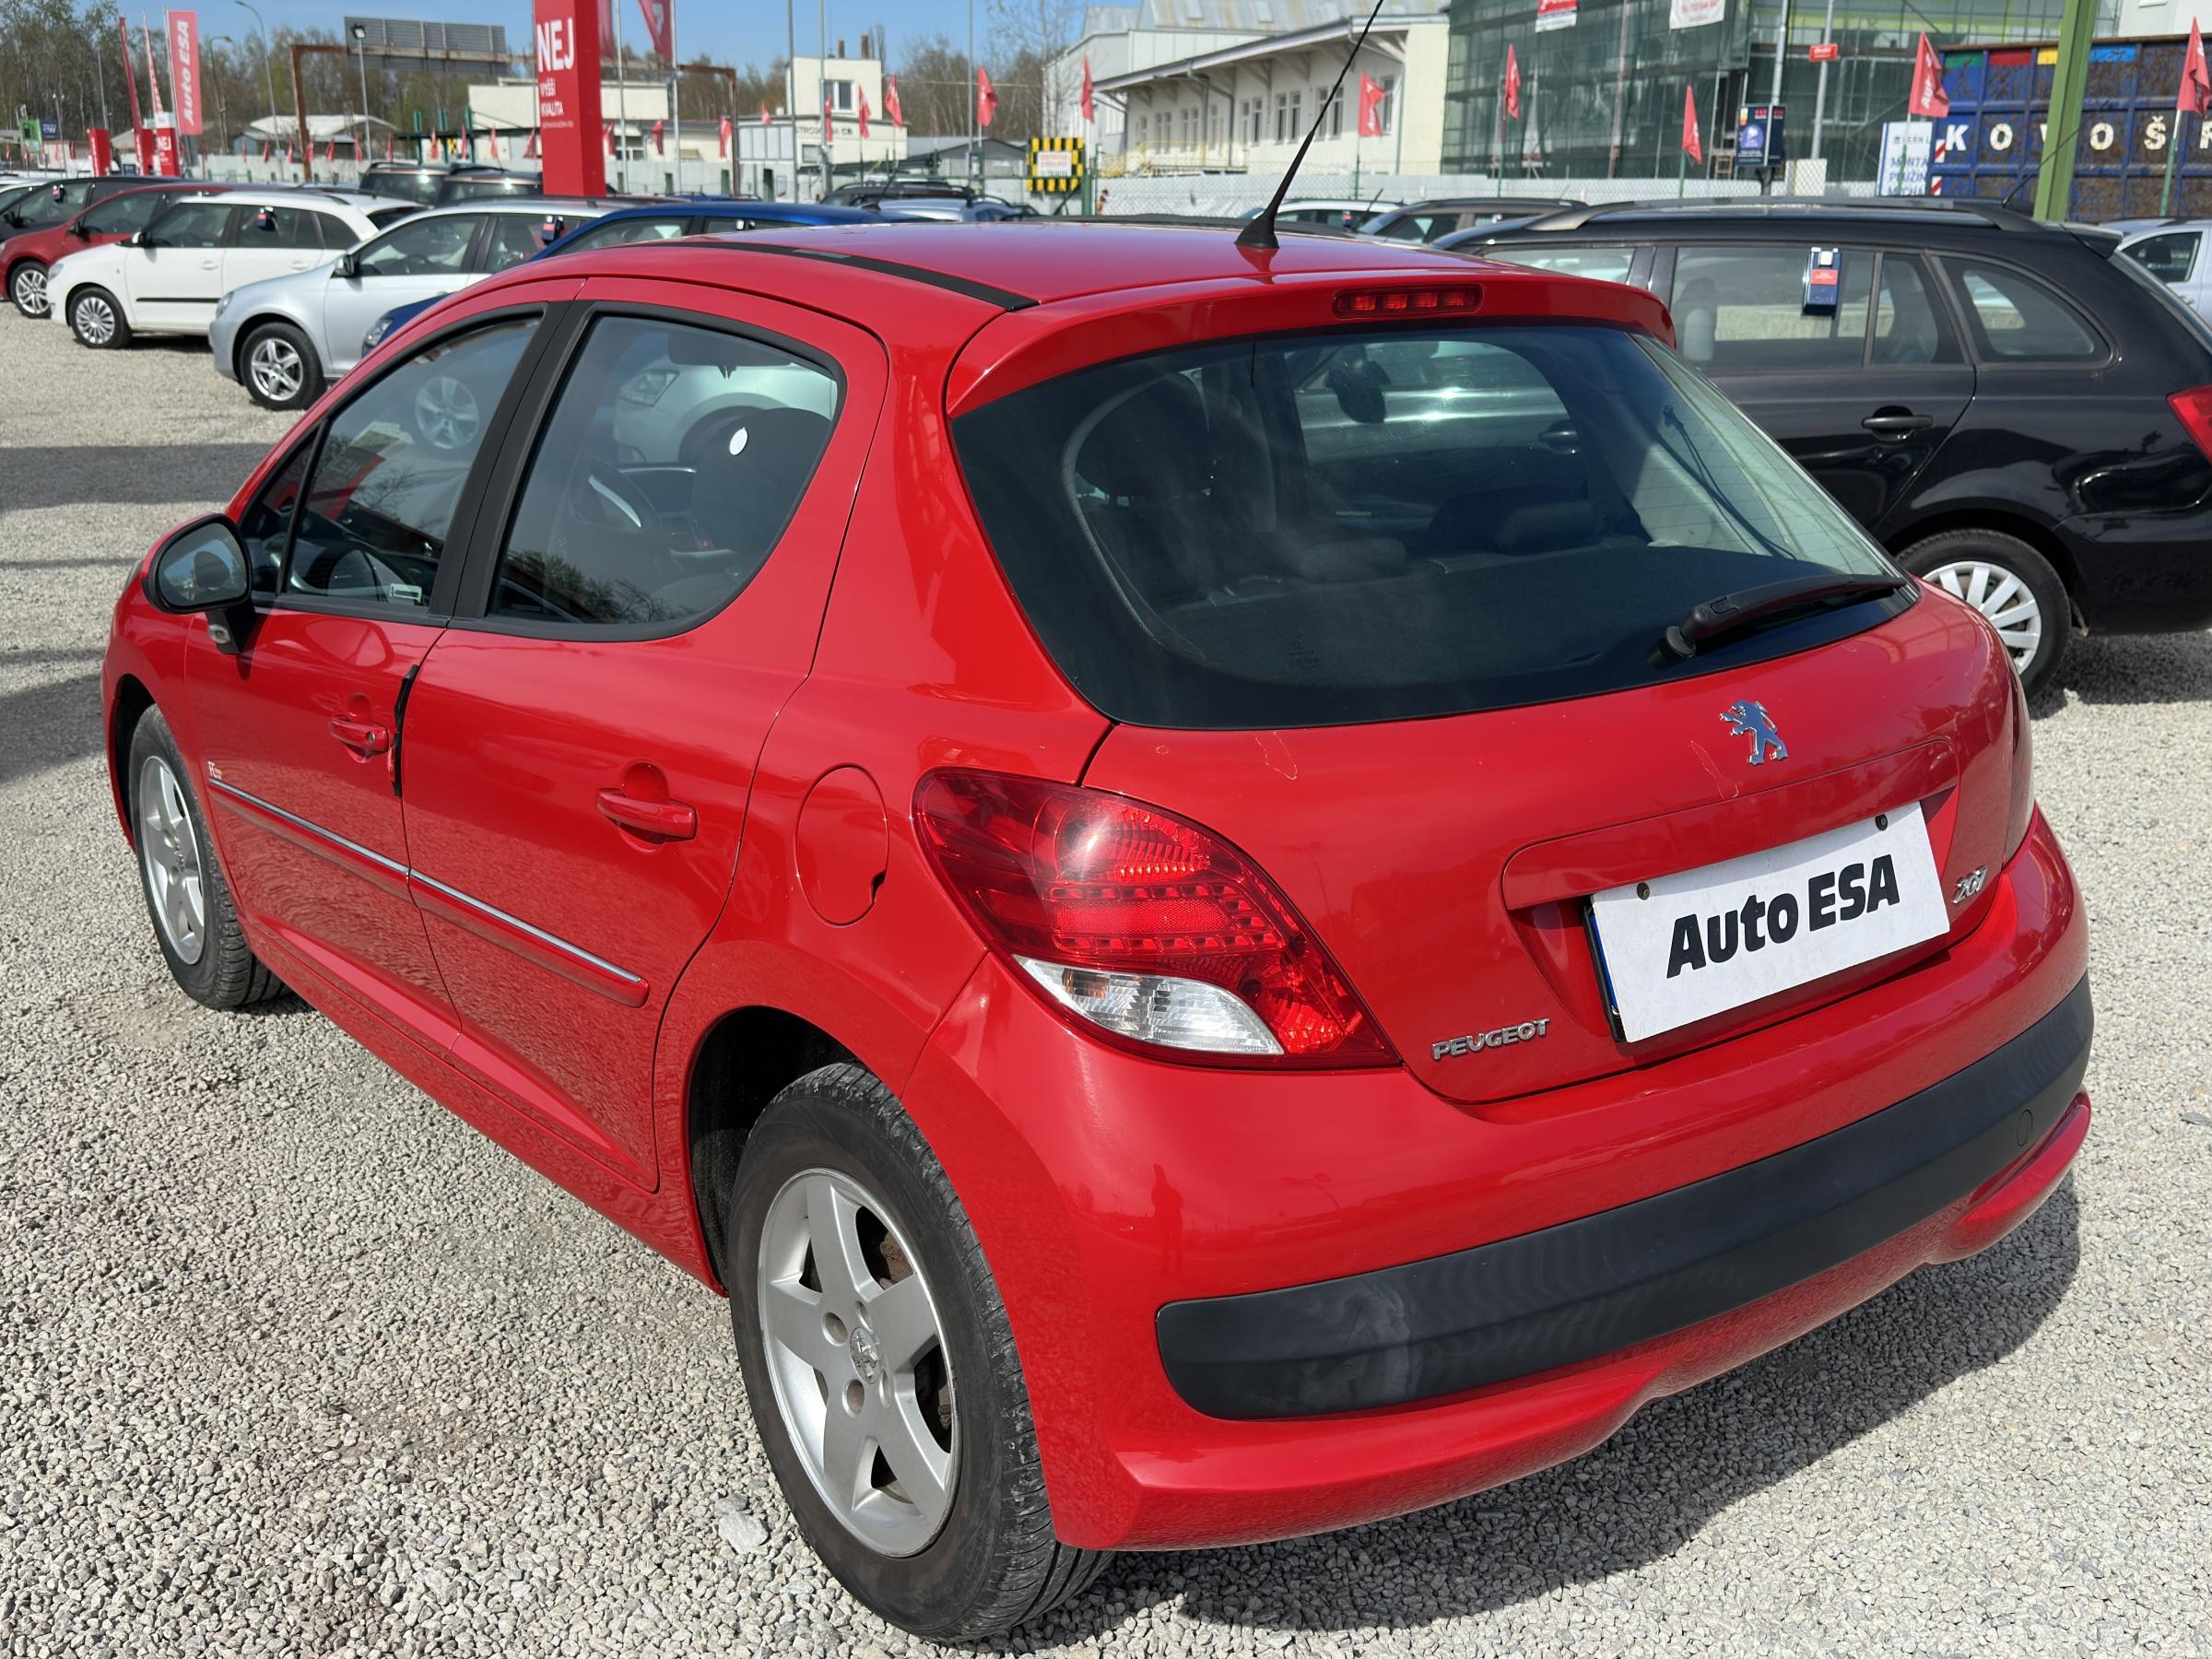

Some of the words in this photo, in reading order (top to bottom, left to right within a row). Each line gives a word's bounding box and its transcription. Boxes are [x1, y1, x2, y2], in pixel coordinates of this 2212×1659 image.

[177, 20, 191, 66] ESA
[536, 17, 575, 73] NEJ
[181, 67, 194, 126] Auto
[540, 100, 564, 117] KVALITA
[1950, 865, 1989, 903] 207
[1665, 893, 1799, 979] Auto
[1807, 853, 1900, 933] ESA
[1431, 1018, 1550, 1060] PEUGEOT
